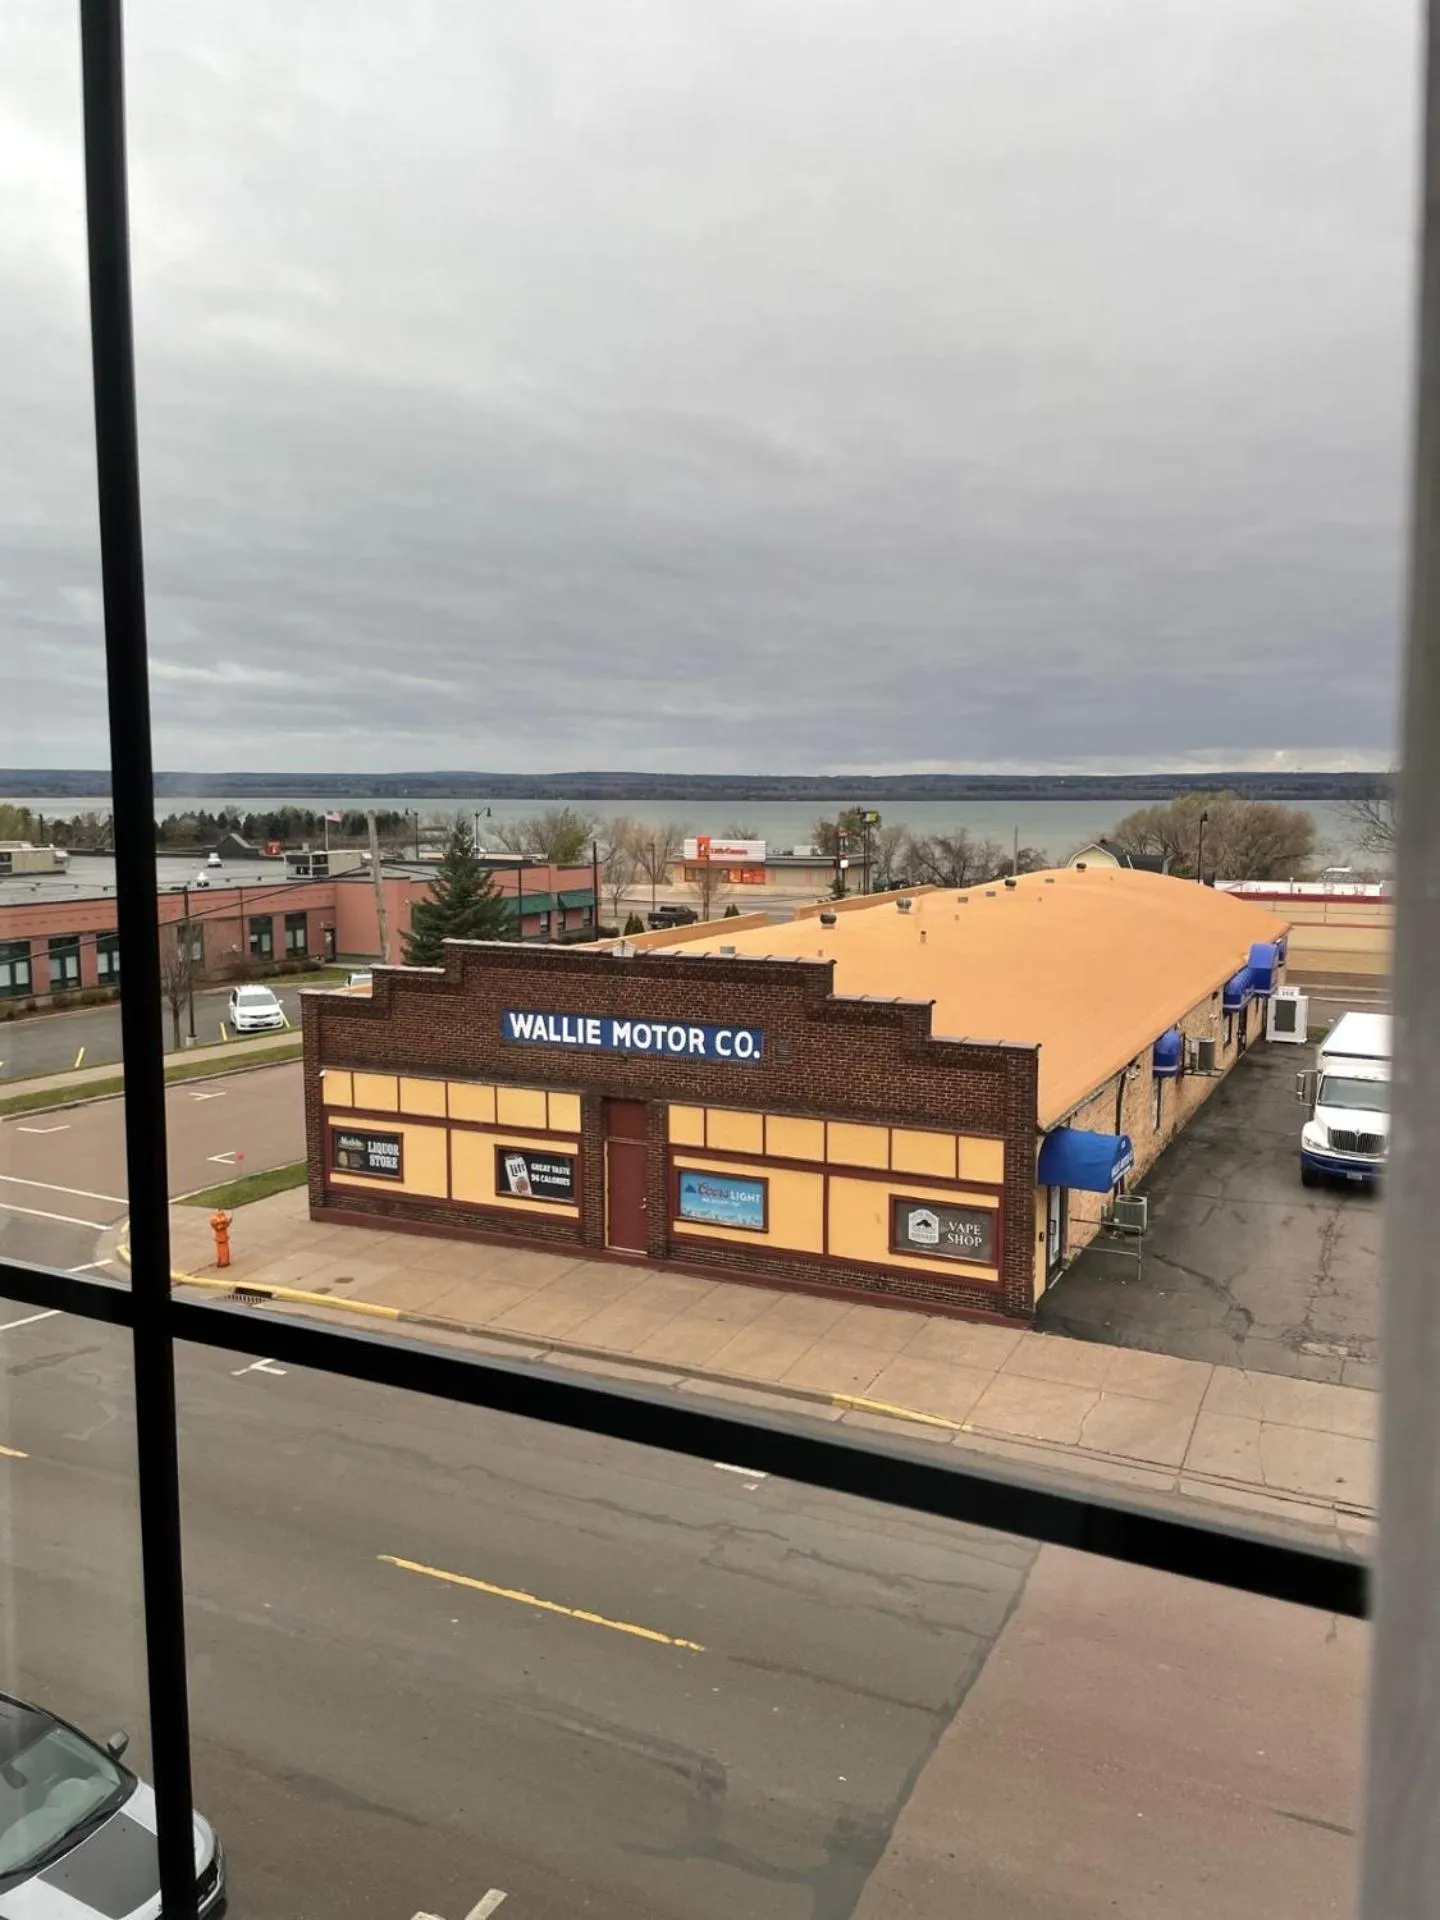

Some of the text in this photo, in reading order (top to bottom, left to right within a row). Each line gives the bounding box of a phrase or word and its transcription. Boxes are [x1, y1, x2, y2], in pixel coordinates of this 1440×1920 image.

[509, 1013, 761, 1059] WALLIE MOTOR CO.
[367, 1141, 400, 1156] LIQUOR
[369, 1154, 398, 1169] STORE
[530, 1163, 571, 1175] GREAT TASTE
[541, 1175, 571, 1186] CALORIES
[730, 1190, 761, 1204] LIGHT
[949, 1221, 981, 1235] VAPE
[947, 1232, 983, 1247] SHOP
